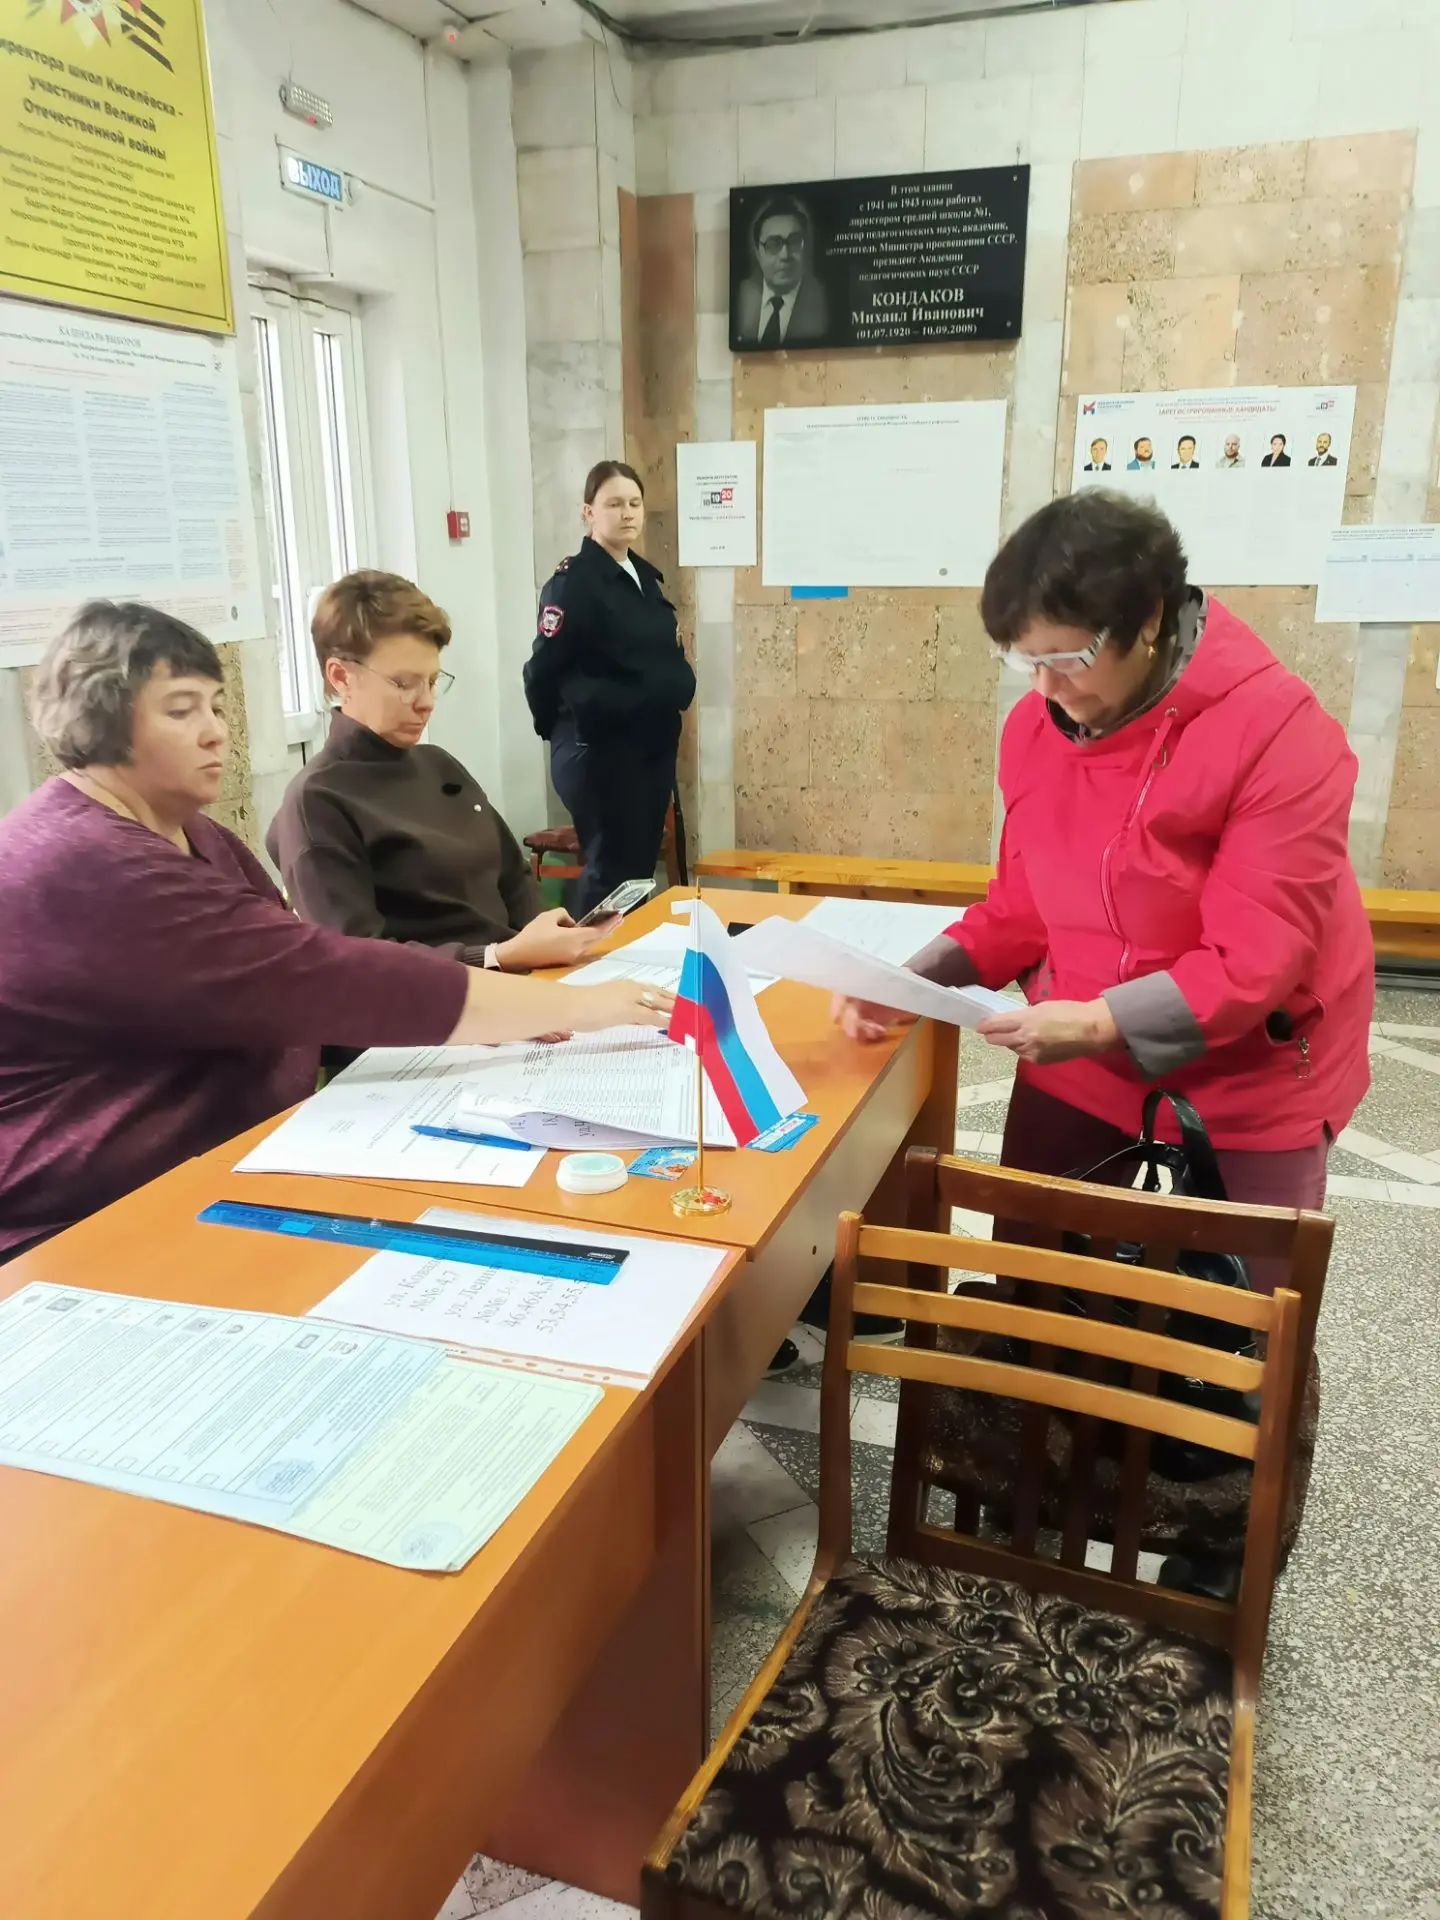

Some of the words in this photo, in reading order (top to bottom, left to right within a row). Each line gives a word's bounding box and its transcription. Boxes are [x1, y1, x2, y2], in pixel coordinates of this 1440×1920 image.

[69, 64, 103, 87] школ
[106, 76, 176, 116] Киселёвска
[28, 74, 101, 112] участники
[103, 100, 157, 133] Великой
[22, 97, 126, 146] Отечественной
[128, 138, 167, 161] войны
[287, 156, 341, 200] ВЫХОД
[891, 184, 898, 195] В
[900, 184, 920, 195] этом
[923, 183, 953, 195] здании
[859, 203, 864, 212] с
[866, 199, 885, 212] 1941
[887, 202, 898, 210] по
[921, 197, 944, 209] годы
[945, 193, 982, 209] работал
[849, 213, 900, 227] директором
[902, 210, 937, 225] средней
[939, 208, 972, 220] школы
[834, 230, 864, 243] доктор
[866, 225, 934, 242] педагогических
[879, 241, 924, 253] Министра
[926, 237, 985, 250] просвещения
[873, 257, 916, 268] президент
[918, 253, 964, 265] Академии
[858, 269, 926, 283] педагогических
[928, 267, 950, 280] наук
[951, 264, 980, 276] СССР
[872, 288, 965, 308] КОНДАКОВ
[851, 310, 908, 325] Михаил
[911, 307, 985, 322] Иванович
[856, 327, 911, 340] (01.07.1920
[721, 489, 732, 500] 20
